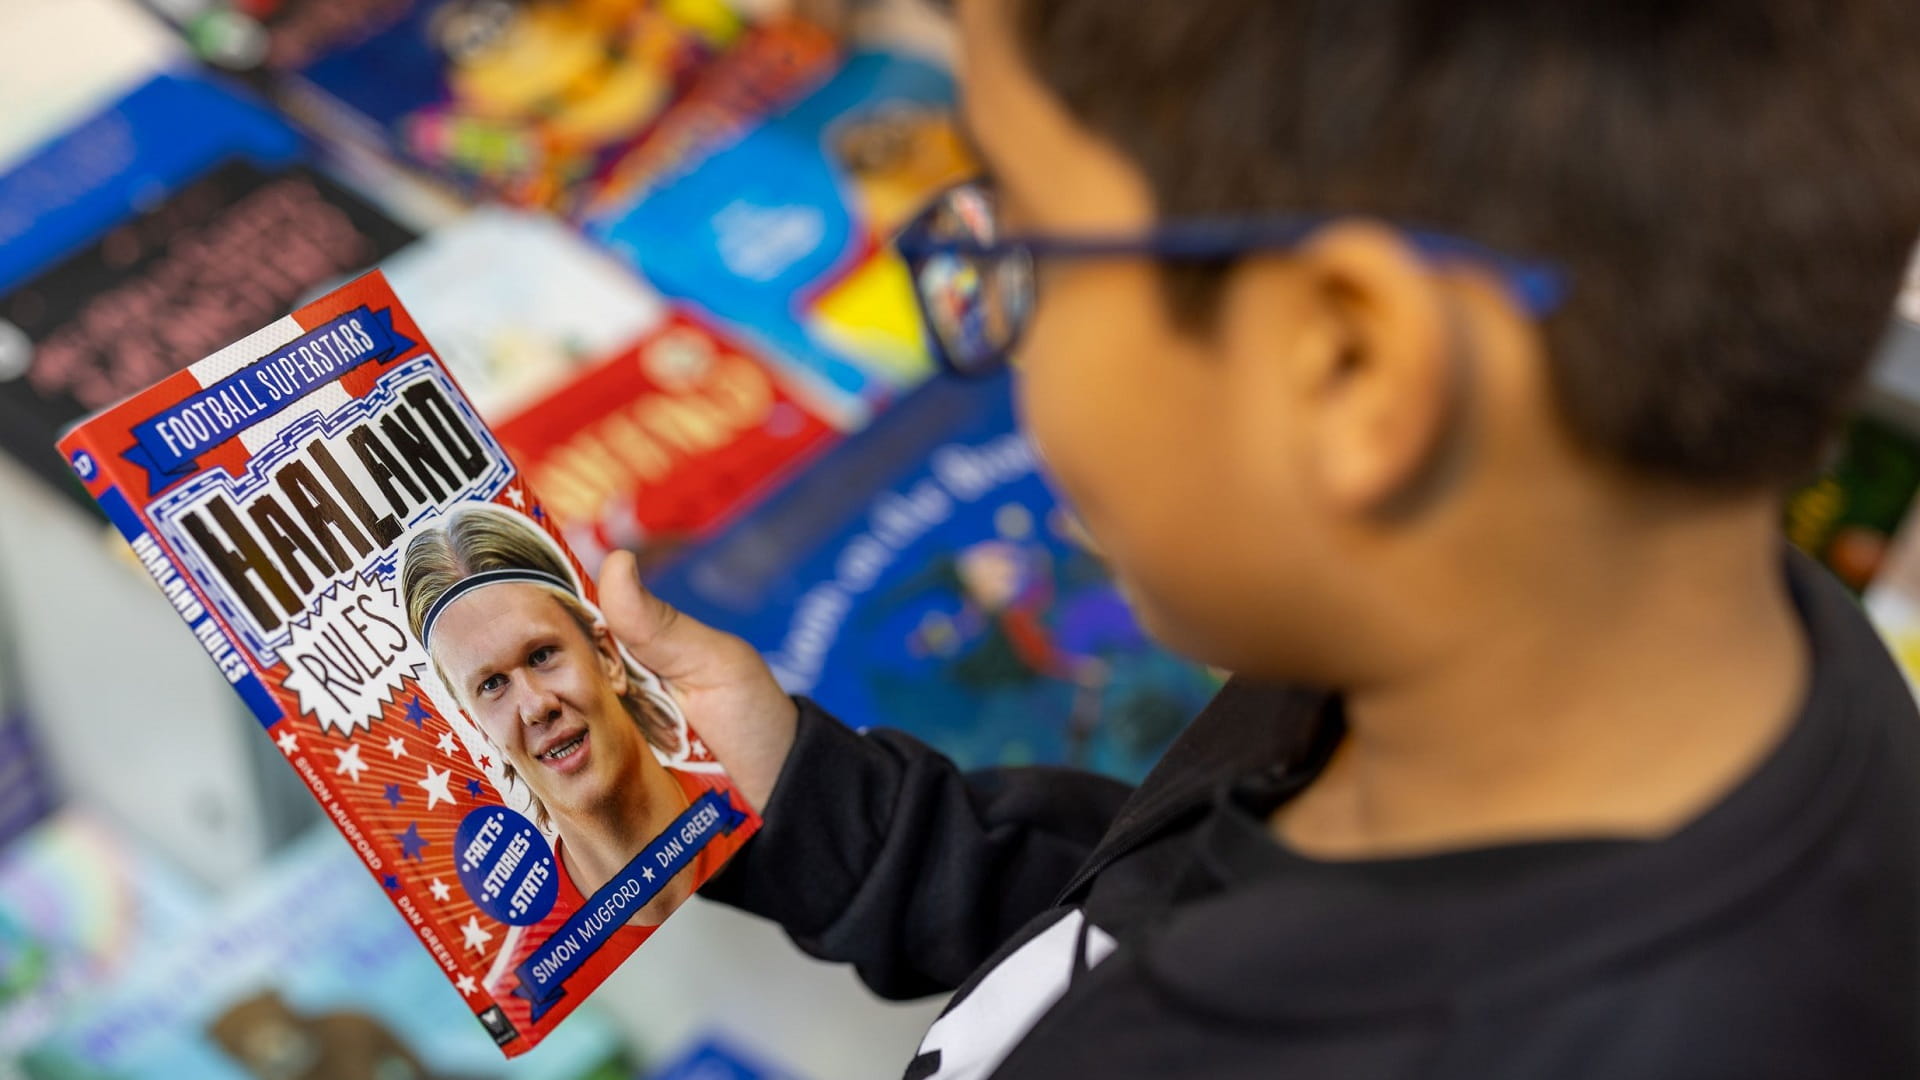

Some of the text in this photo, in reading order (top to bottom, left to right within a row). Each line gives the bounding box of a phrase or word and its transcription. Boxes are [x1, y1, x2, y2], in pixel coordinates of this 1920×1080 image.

[155, 318, 375, 458] FOOTBALL SUPERSTARS
[180, 377, 490, 634] HAALAND
[131, 531, 250, 684] HAALAND RULES
[297, 594, 408, 714] RULES
[295, 756, 458, 973] SIMON MUGFORD DAN GREEN
[463, 815, 504, 870] FACTS
[482, 834, 531, 899] STORIES
[513, 862, 551, 915] STATS
[532, 801, 721, 985] SIMON MUGFORD DAN GREEN
